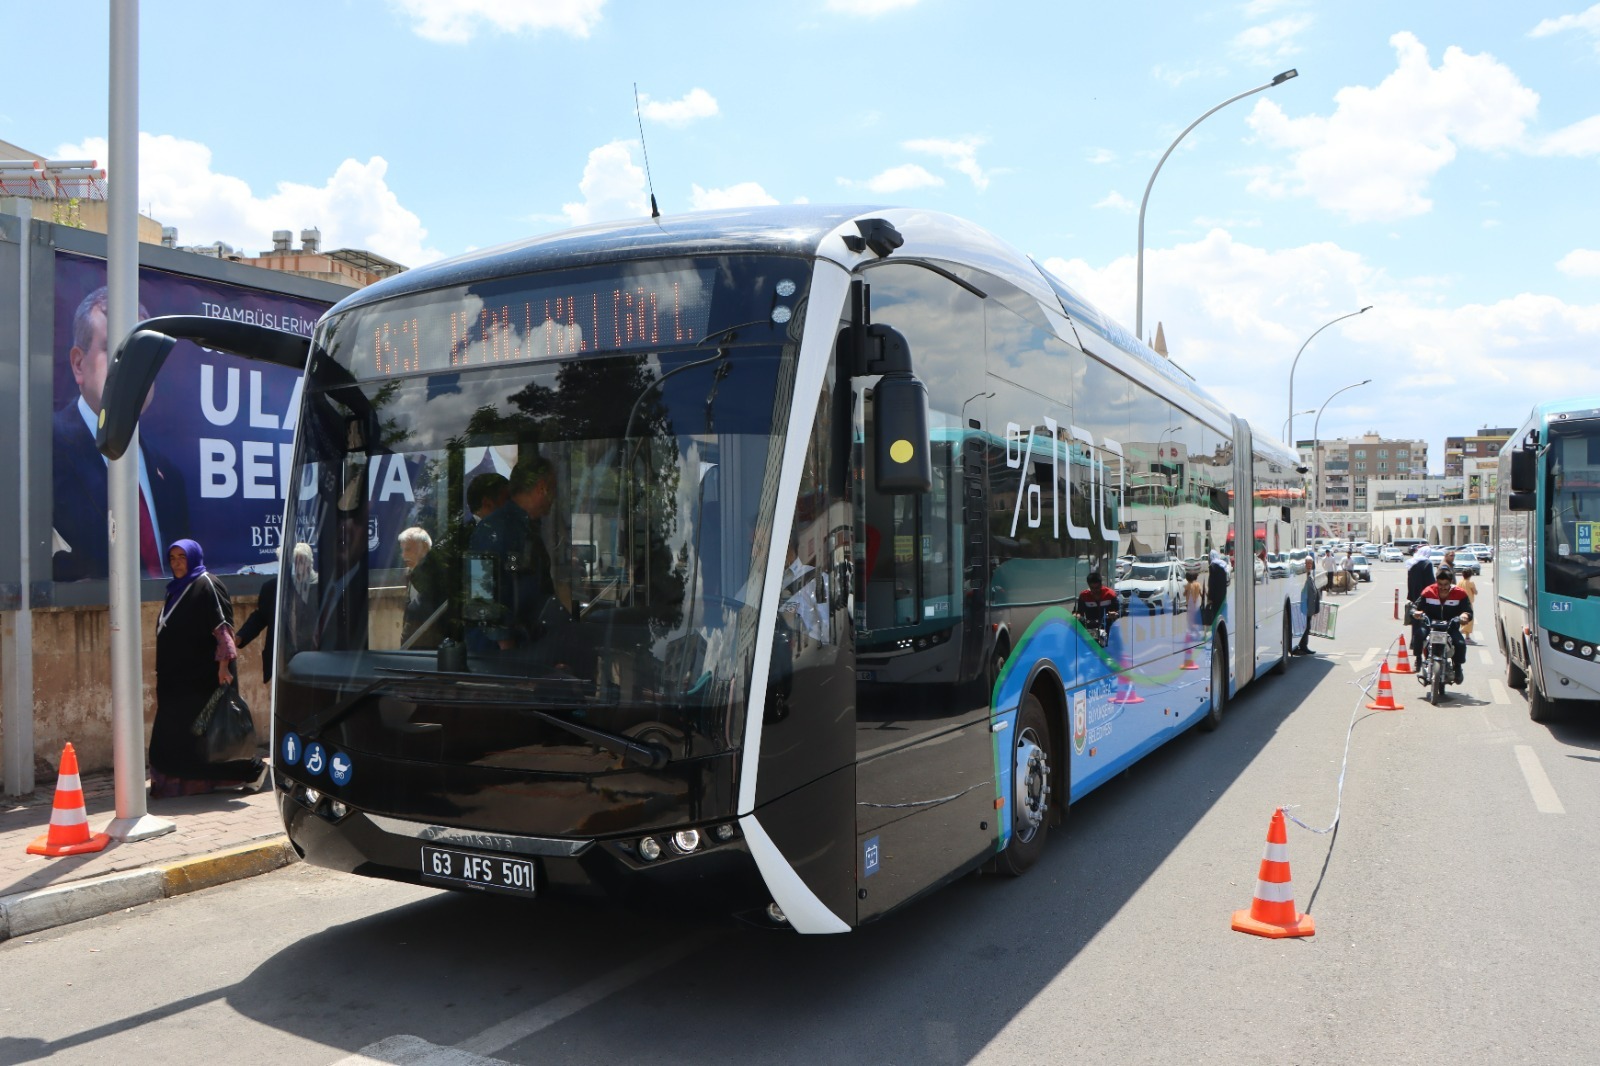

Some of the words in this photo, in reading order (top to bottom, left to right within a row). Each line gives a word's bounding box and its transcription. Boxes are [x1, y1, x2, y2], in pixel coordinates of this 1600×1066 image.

[1579, 525, 1589, 537] 51
[432, 852, 452, 876] 63
[463, 856, 493, 881] AFS
[502, 861, 531, 888] 501
